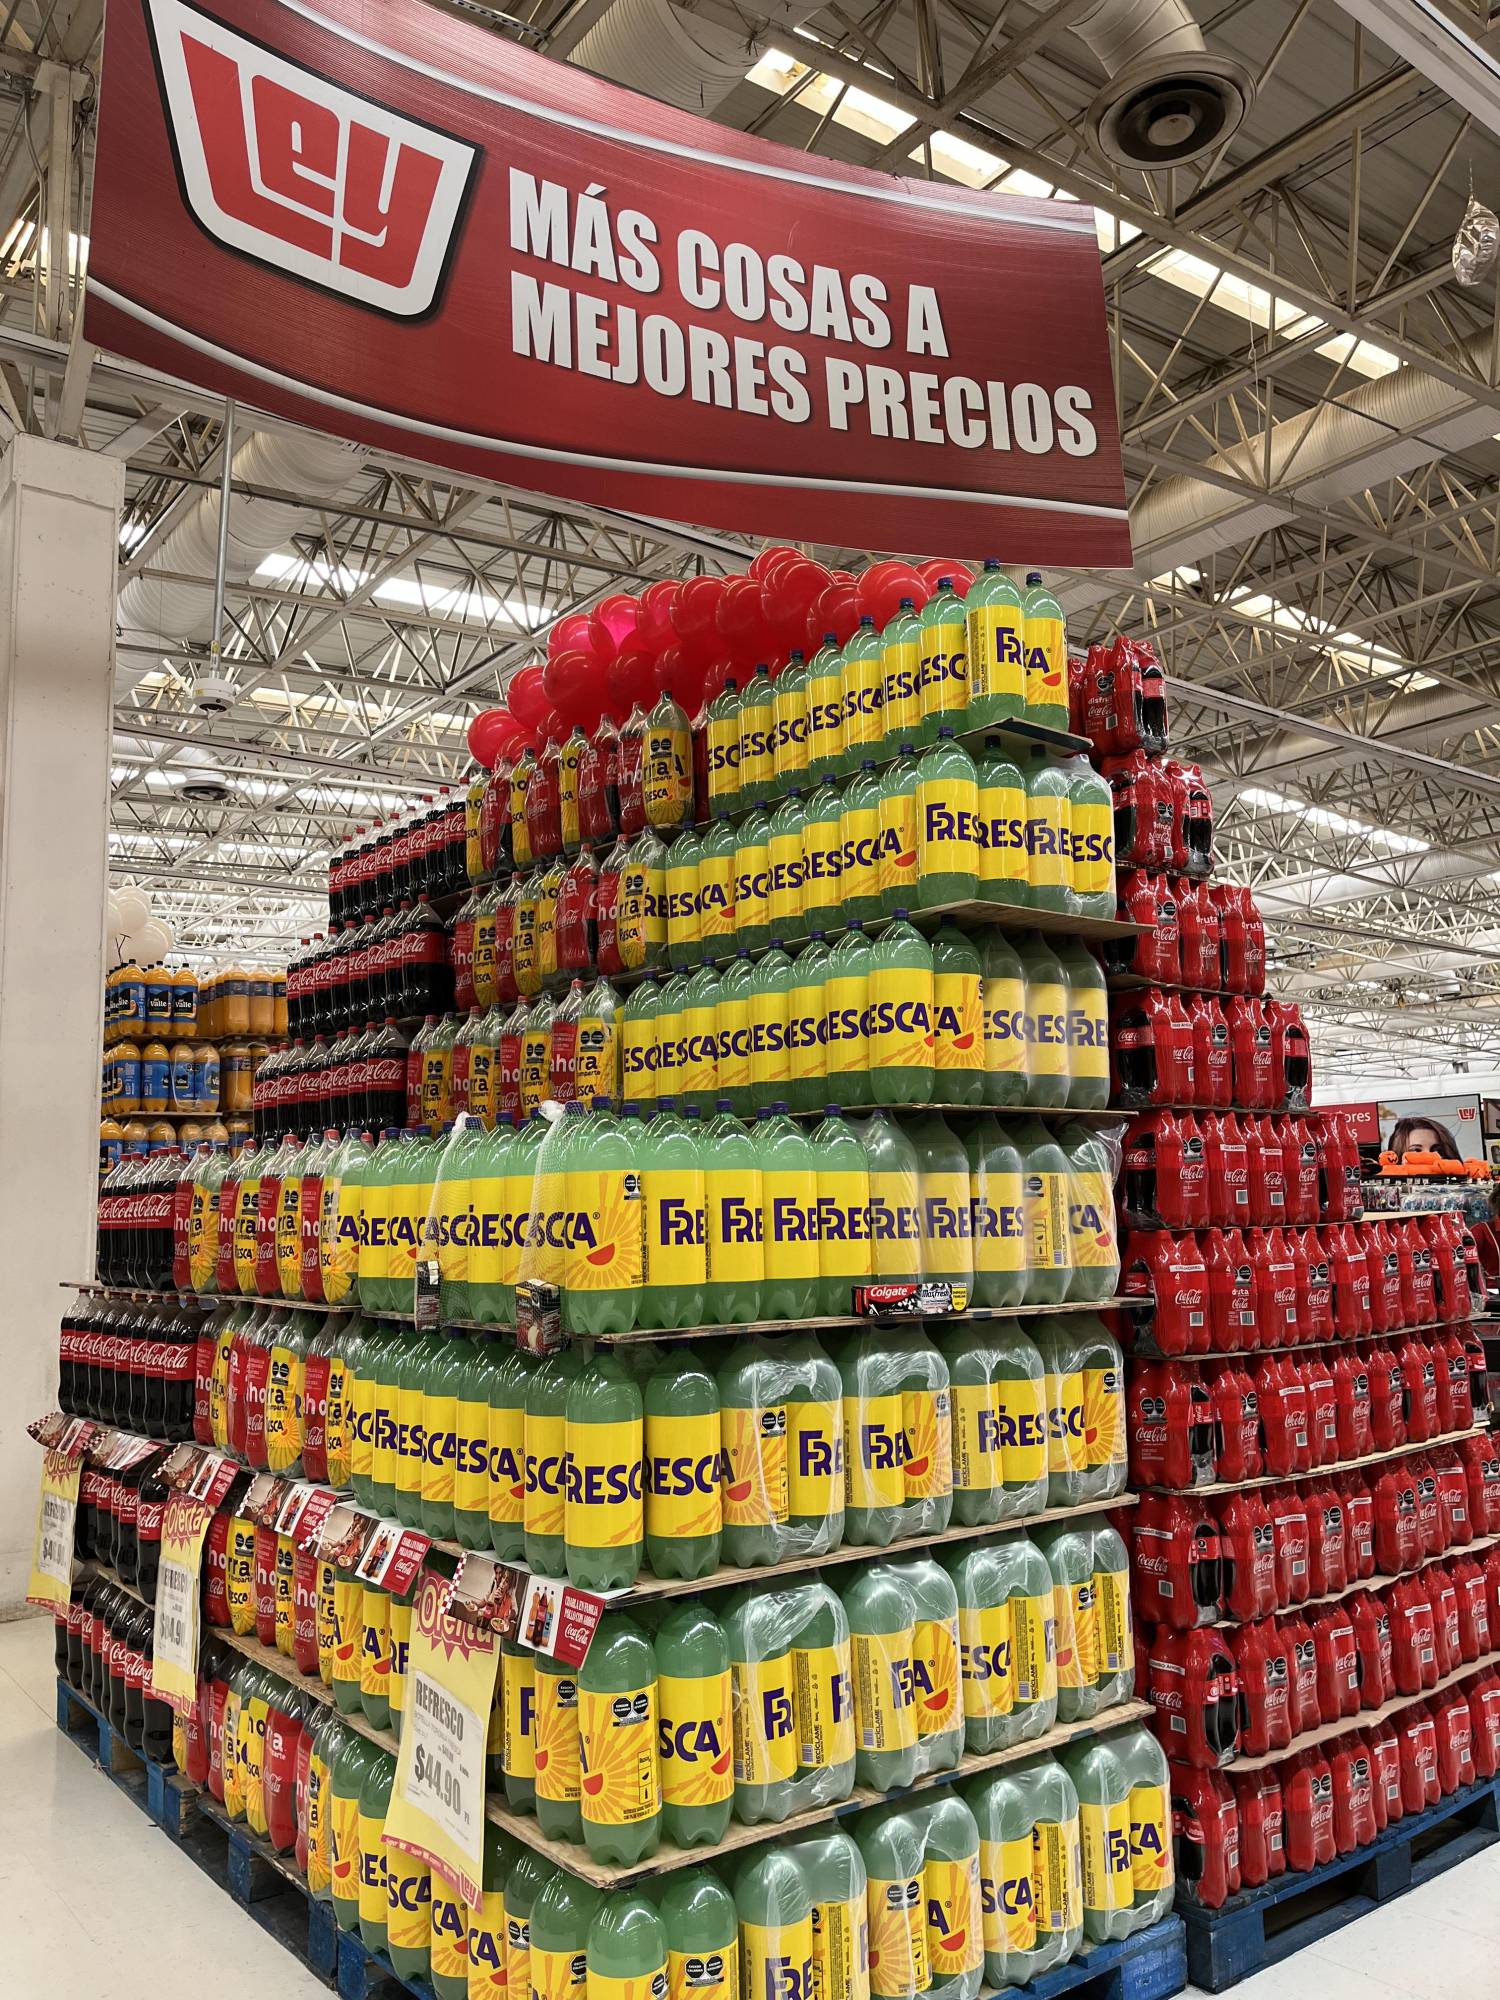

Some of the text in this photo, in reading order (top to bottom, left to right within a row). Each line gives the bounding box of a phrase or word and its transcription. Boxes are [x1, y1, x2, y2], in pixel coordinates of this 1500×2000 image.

[181, 30, 445, 288] Ley
[508, 168, 950, 358] MÁS COSAS A
[511, 270, 1098, 456] MEJORES PRECIOS
[871, 1287, 907, 1299] Colgate
[1136, 1426, 1167, 1443] Coca-Cola
[167, 1503, 205, 1534] Oferta
[1138, 1552, 1168, 1573] Coca-Cola
[565, 1623, 590, 1645] Coca-Cola
[416, 1679, 463, 1742] REFRESCO
[414, 1744, 461, 1815] $44.90
